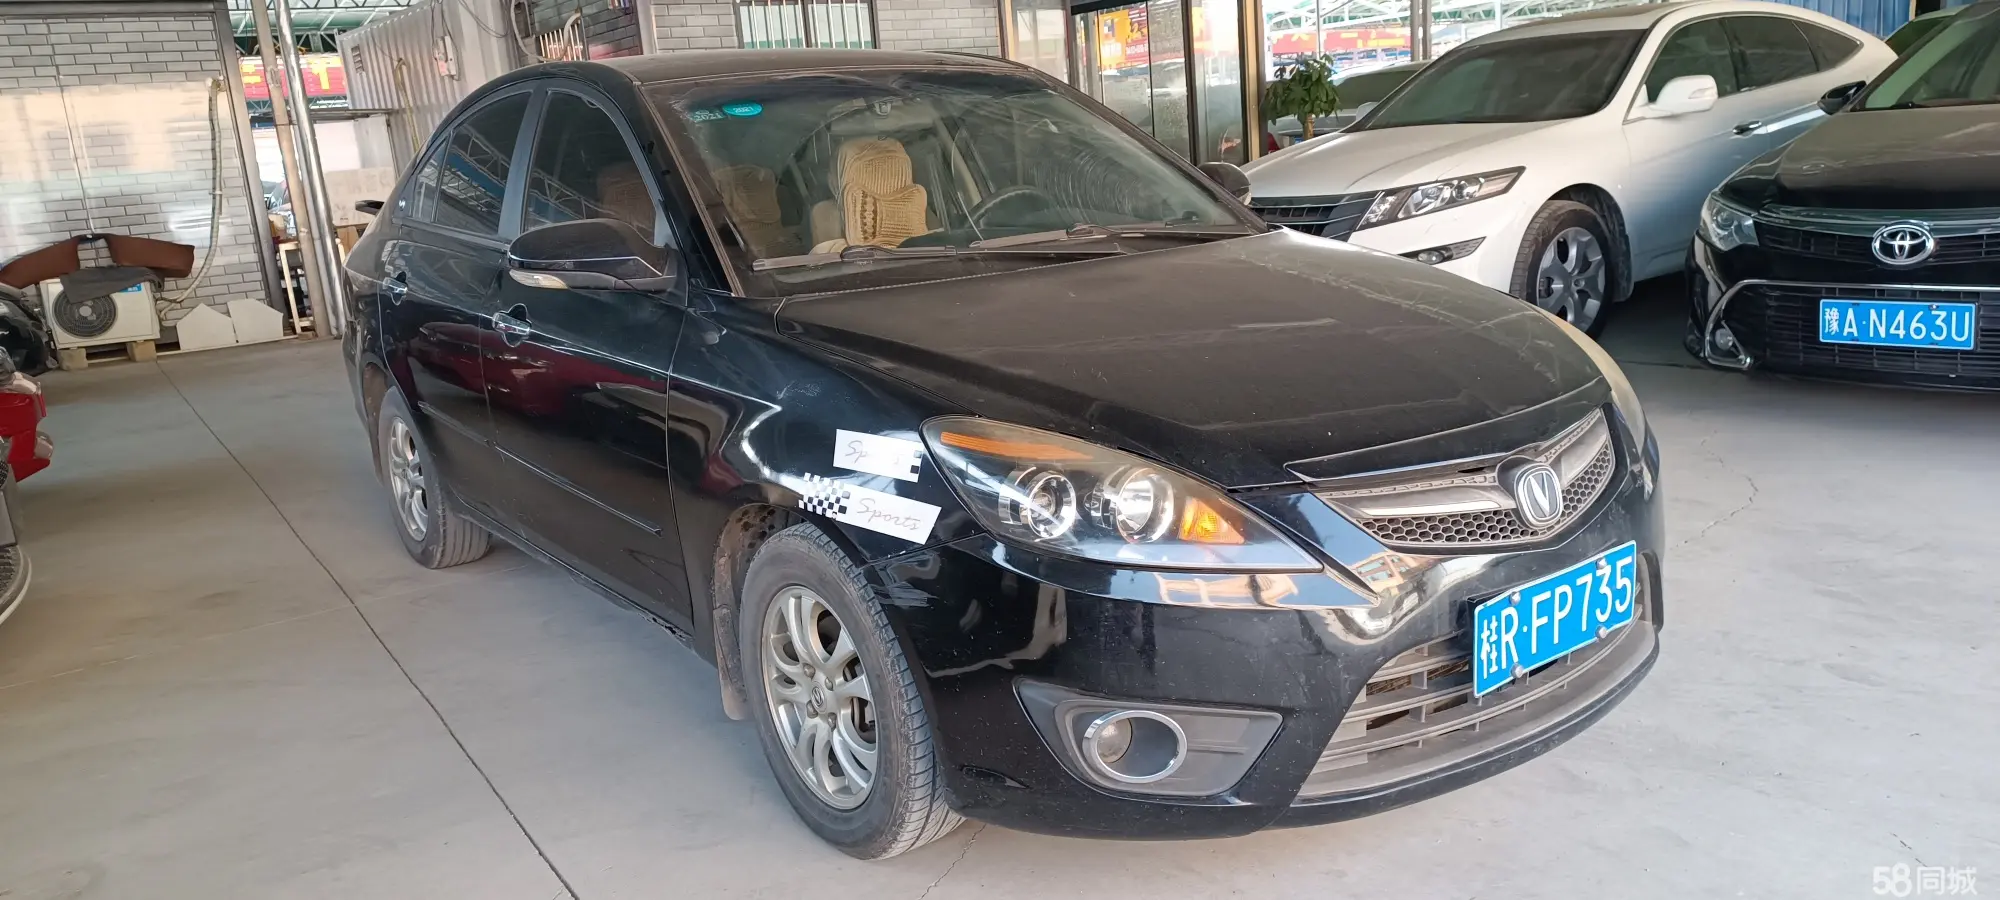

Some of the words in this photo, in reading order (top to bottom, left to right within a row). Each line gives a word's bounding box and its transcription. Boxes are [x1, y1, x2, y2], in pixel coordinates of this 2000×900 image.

[1824, 307, 1970, 342] 豫A·N463U
[857, 498, 921, 531] Sports
[1481, 556, 1633, 679] 桂R·FP735
